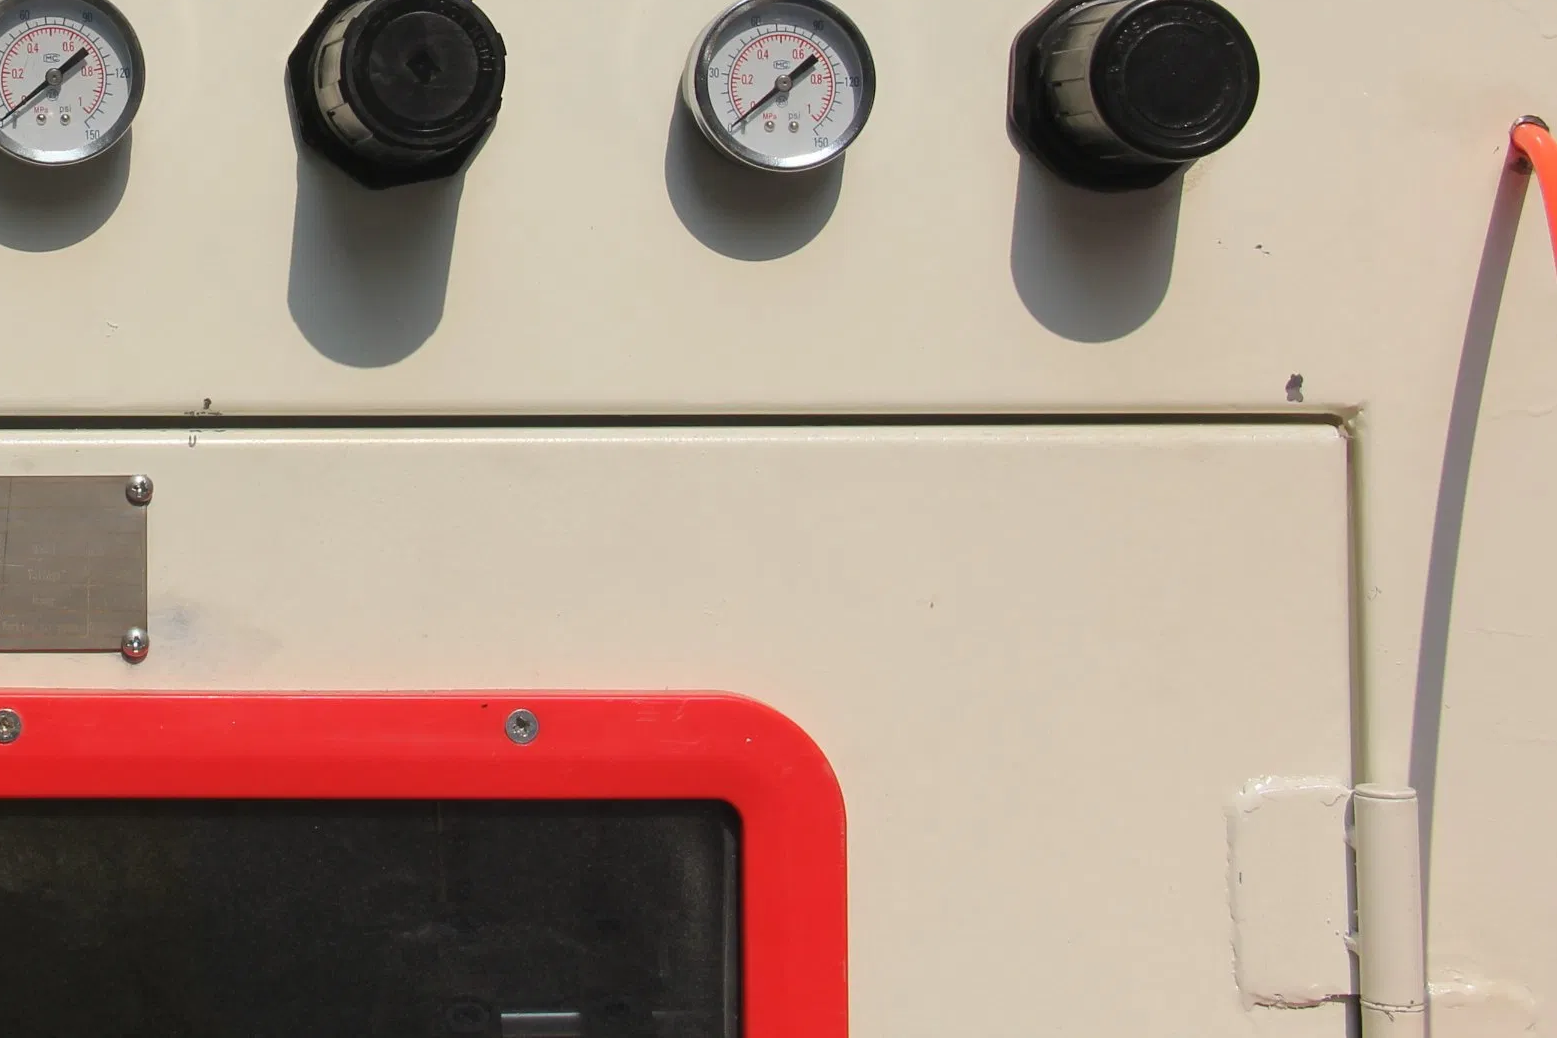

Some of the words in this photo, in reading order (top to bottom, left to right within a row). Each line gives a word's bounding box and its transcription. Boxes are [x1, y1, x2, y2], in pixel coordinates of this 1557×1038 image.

[20, 11, 29, 20] 60
[82, 13, 92, 22] 90
[751, 17, 761, 26] 60
[813, 21, 824, 30] 90
[27, 43, 38, 53] 0.4
[63, 42, 74, 51] 0.6
[757, 50, 768, 59] 0.4
[793, 49, 804, 59] 0.6
[12, 69, 23, 79] 0.2
[81, 66, 93, 76] 0.8
[116, 68, 129, 78] 120
[709, 68, 719, 78] 30
[742, 74, 753, 84] 0.2
[811, 75, 822, 84] 0.8
[845, 77, 859, 87] 120
[86, 130, 100, 140] 150
[814, 138, 828, 147] 150
